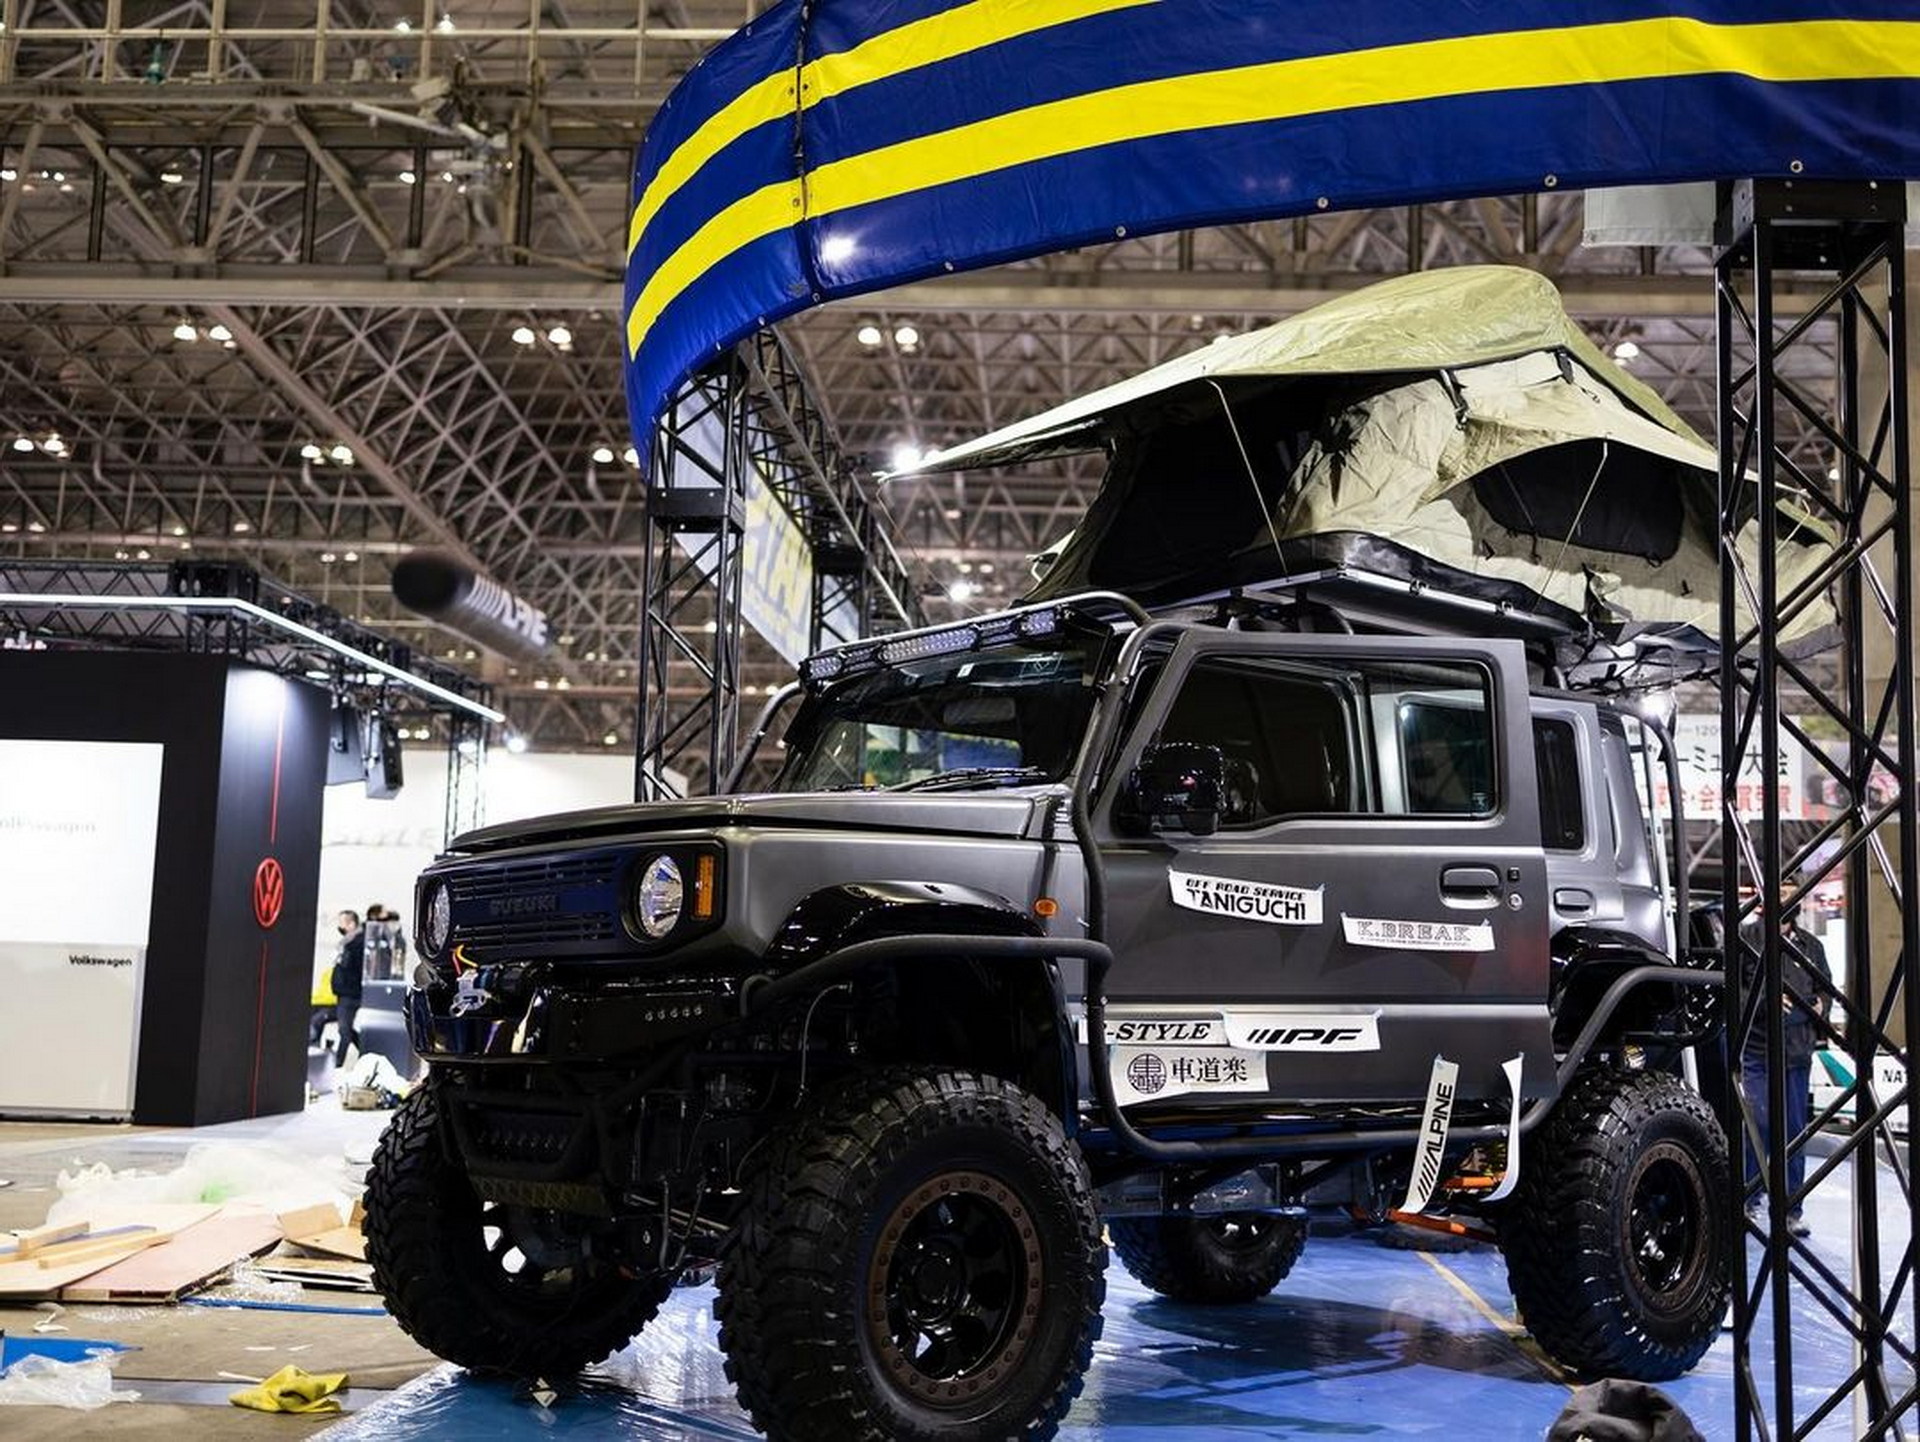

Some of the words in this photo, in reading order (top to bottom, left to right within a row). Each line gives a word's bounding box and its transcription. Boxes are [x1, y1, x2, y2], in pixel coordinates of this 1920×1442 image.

[1186, 878, 1210, 889] OFF
[1215, 881, 1250, 895] ROAD
[1253, 886, 1306, 901] SERVICE
[1186, 888, 1306, 921] TANIGUCHI
[1357, 920, 1471, 942] K.BREAK
[69, 954, 133, 968] Volkswagen
[1103, 1022, 1211, 1041] -STYLE
[1171, 1056, 1248, 1084] 車道楽
